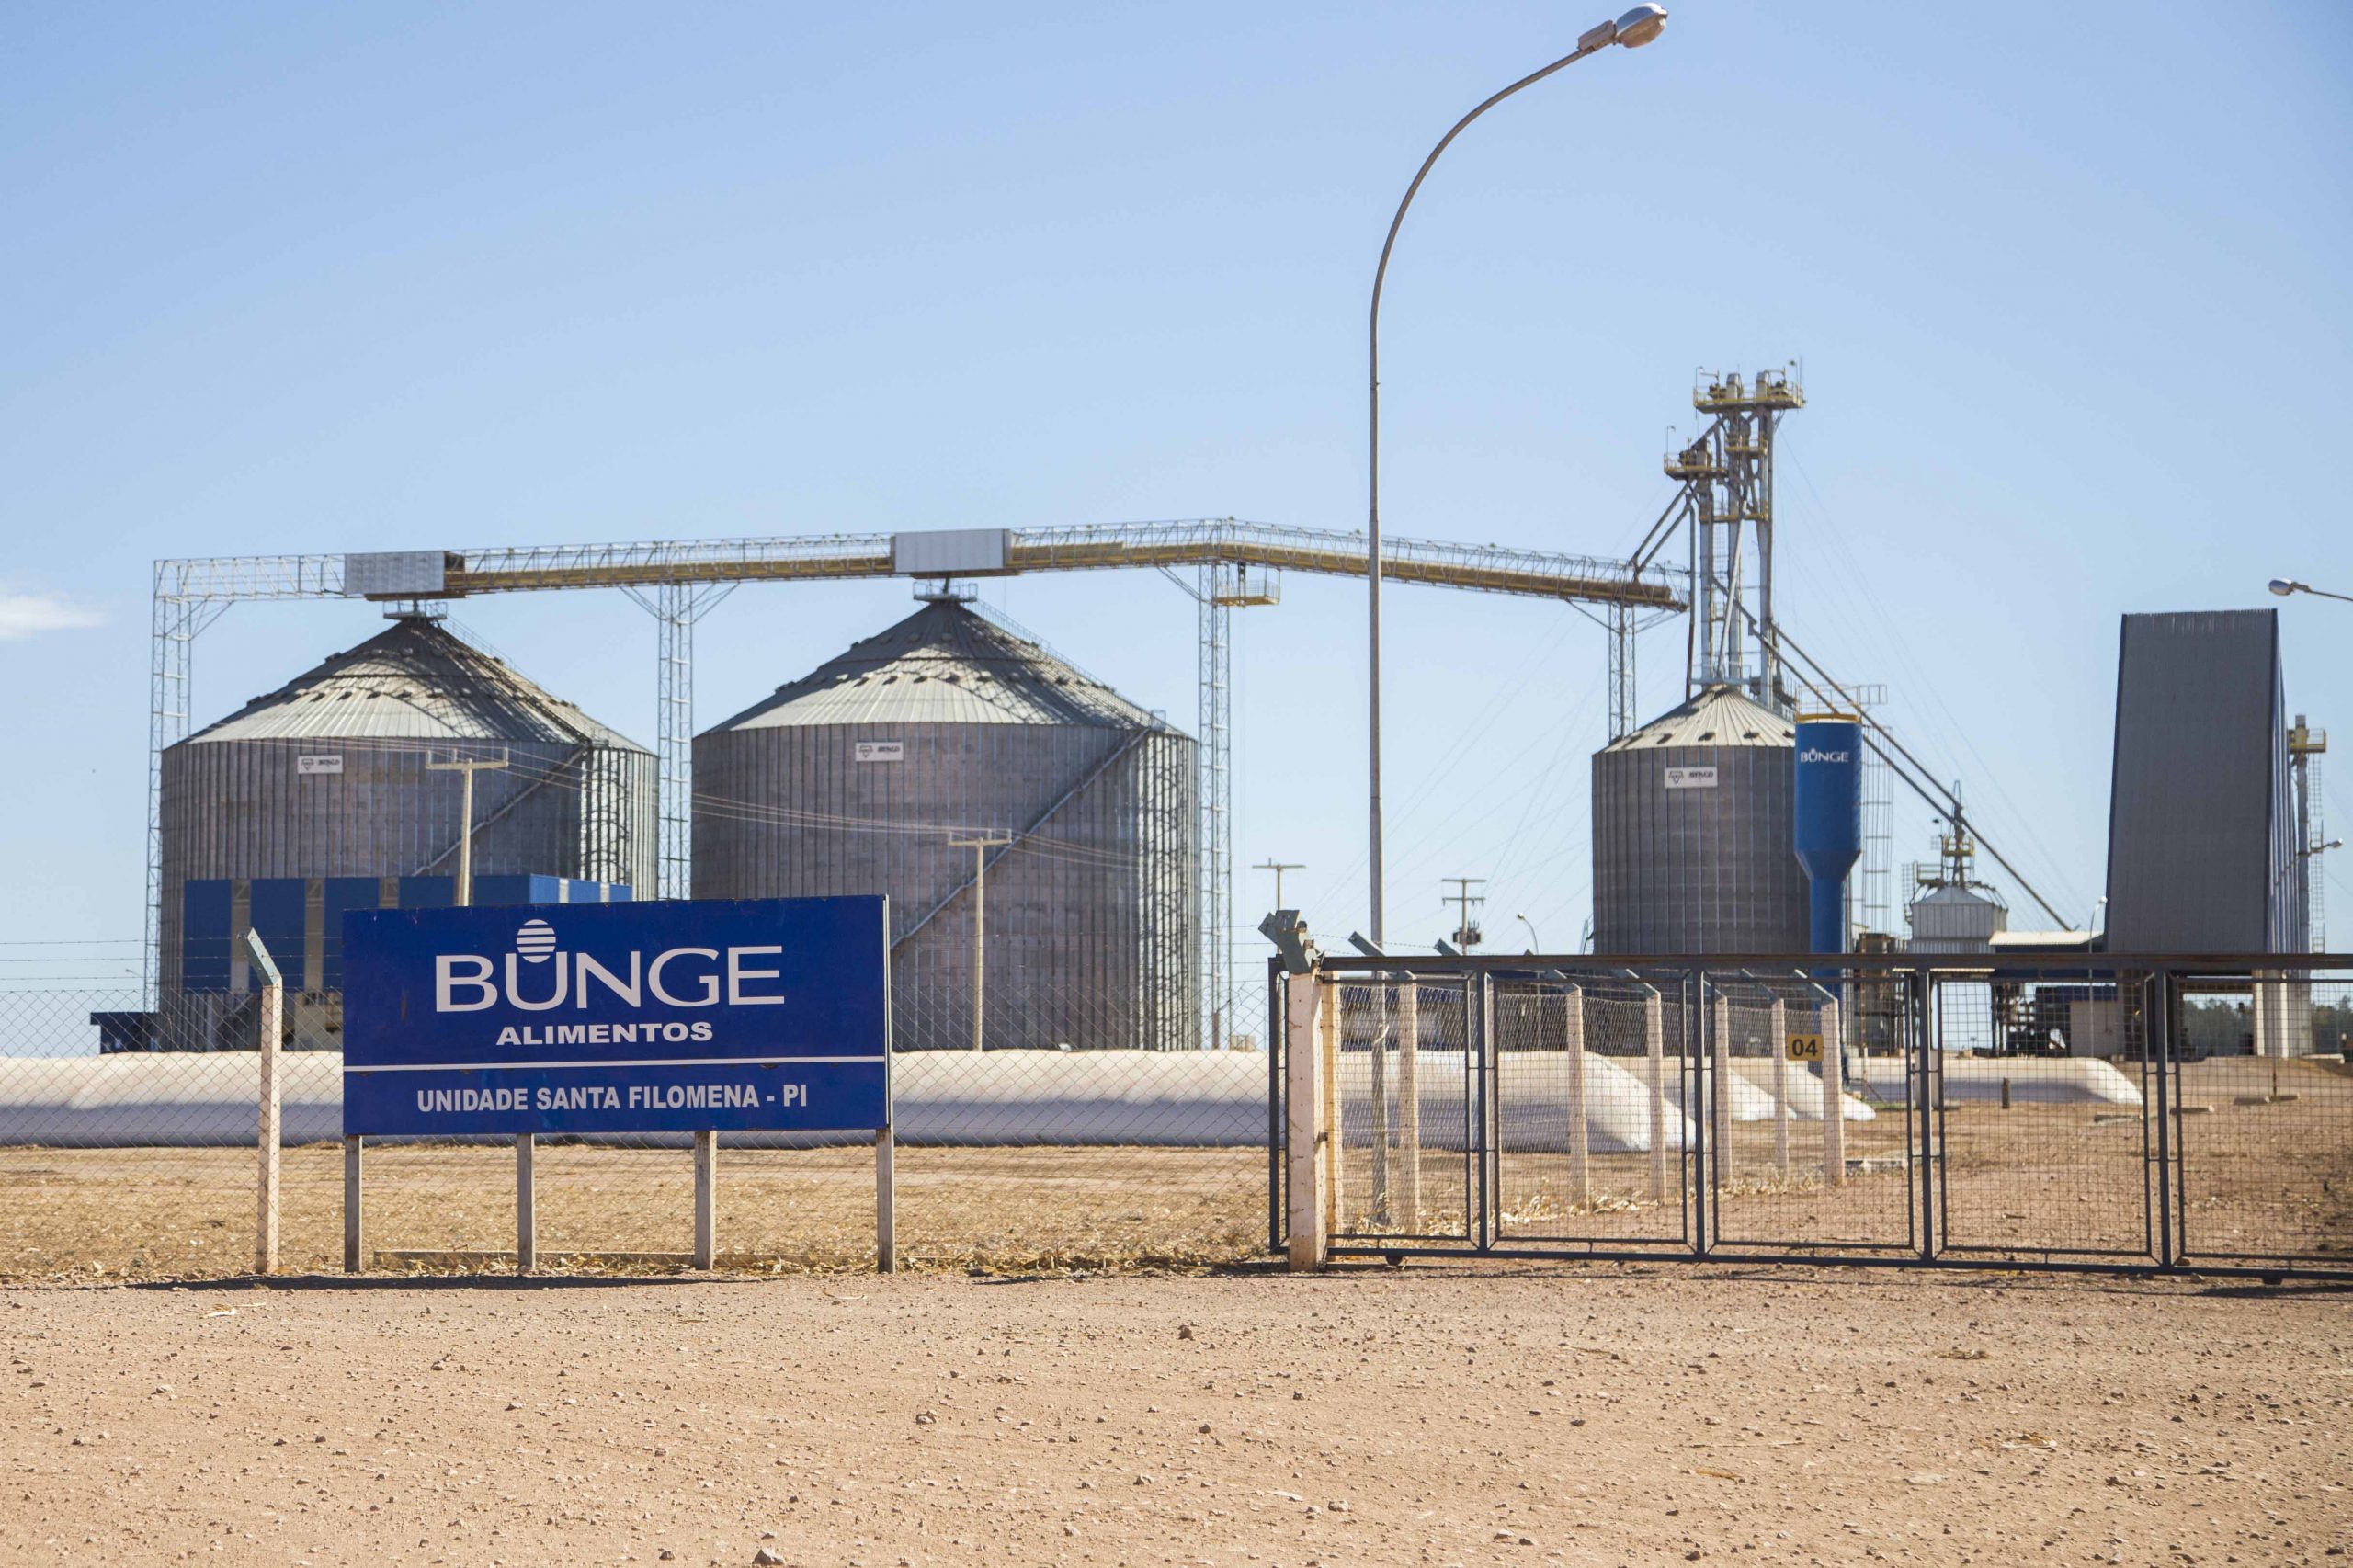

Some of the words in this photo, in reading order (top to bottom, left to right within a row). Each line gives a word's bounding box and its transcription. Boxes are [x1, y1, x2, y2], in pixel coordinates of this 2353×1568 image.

[1800, 748, 1849, 763] BUNGE
[435, 943, 785, 1013] BUNGE
[496, 1021, 713, 1046] ALIMENTOS
[1791, 1039, 1818, 1057] 04
[417, 1088, 529, 1112] UNIDADE
[536, 1087, 621, 1110] SANTA
[629, 1085, 760, 1108] FILOMENA
[783, 1084, 807, 1107] PI
